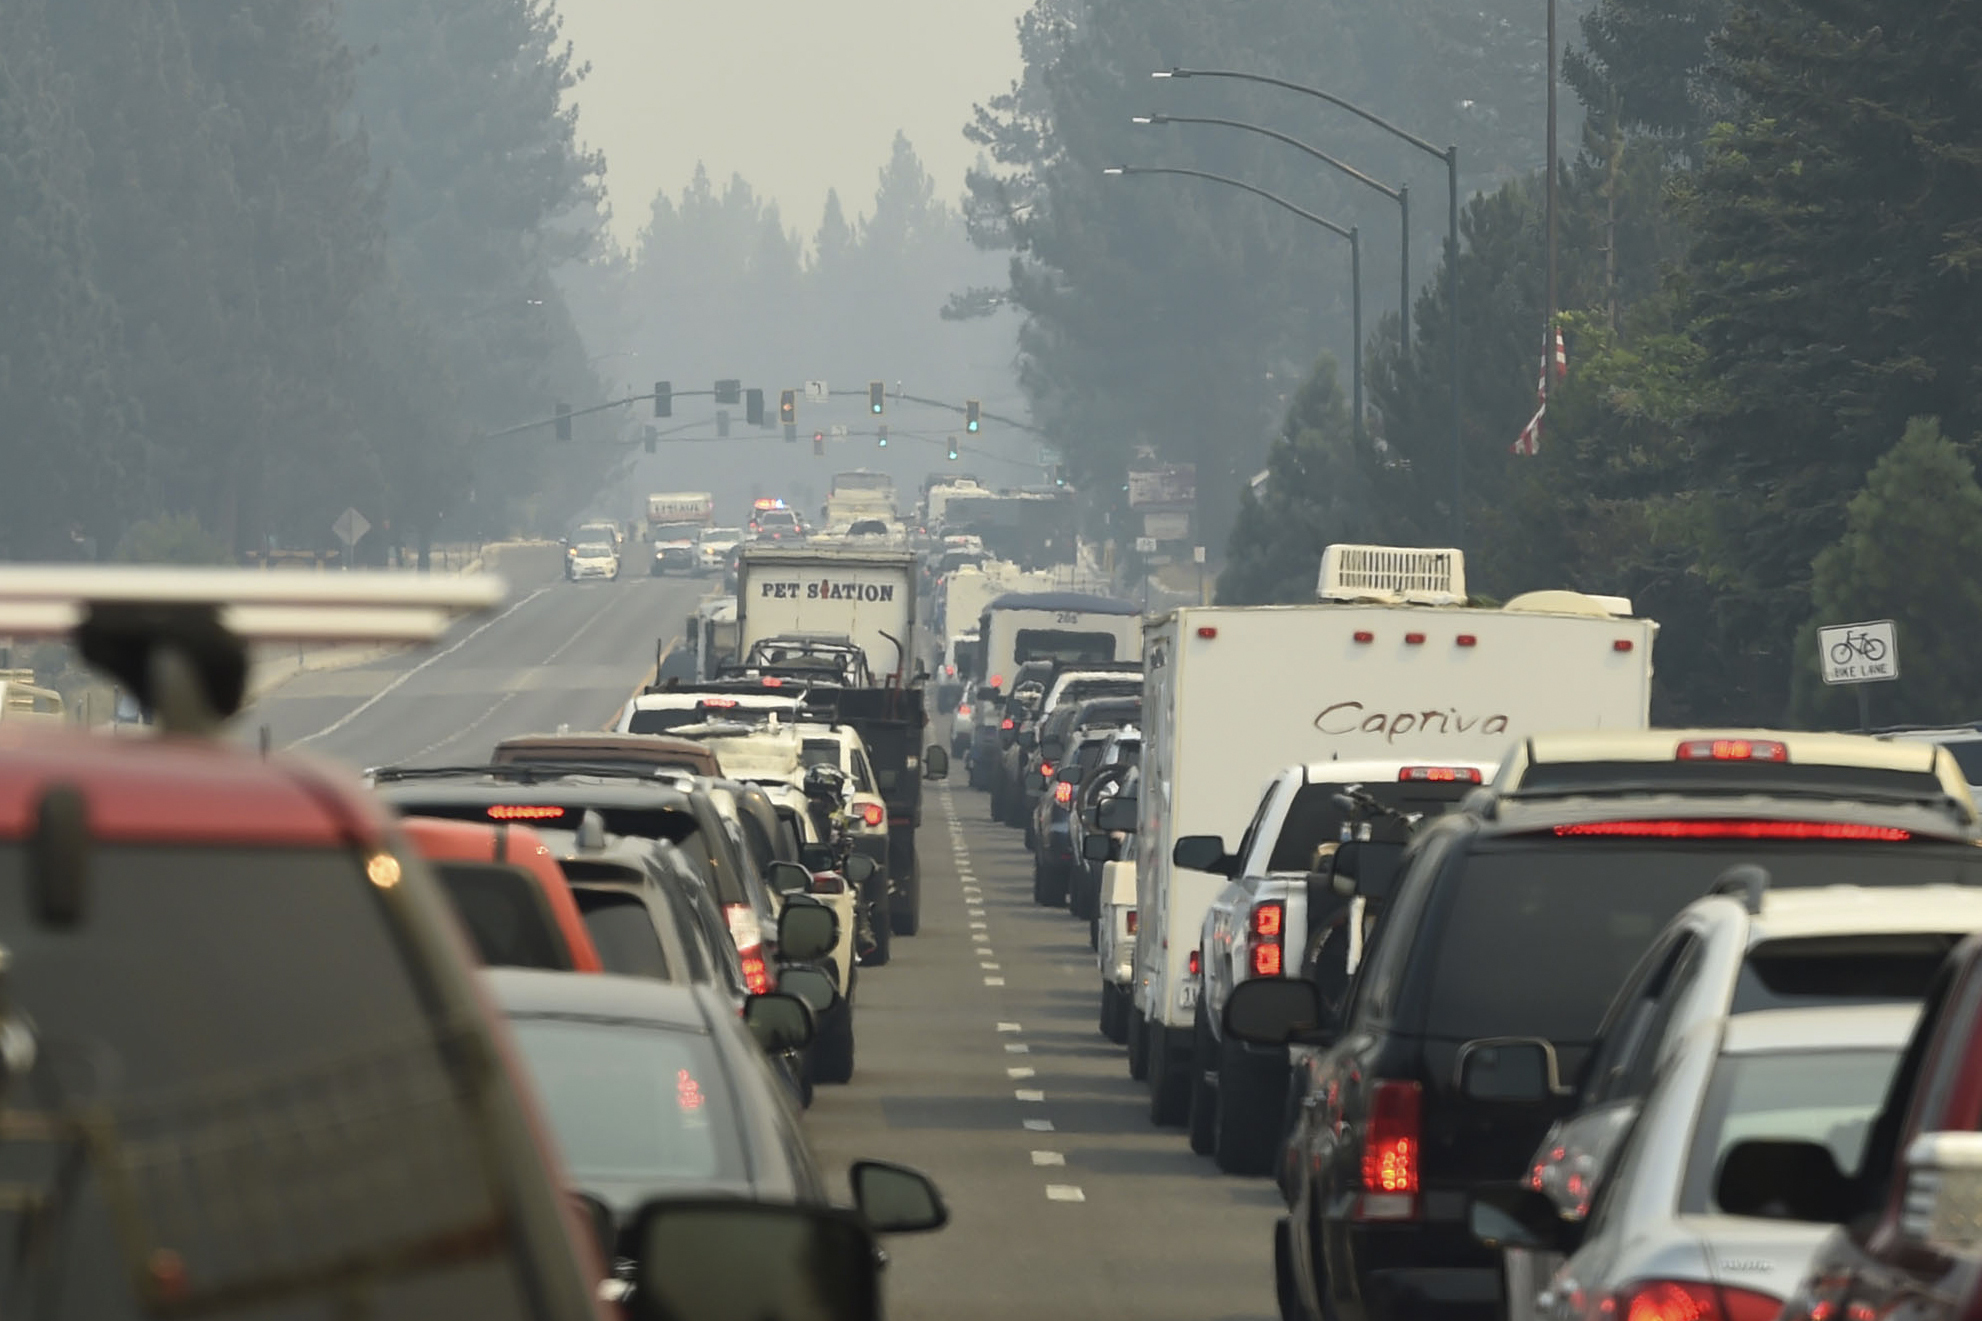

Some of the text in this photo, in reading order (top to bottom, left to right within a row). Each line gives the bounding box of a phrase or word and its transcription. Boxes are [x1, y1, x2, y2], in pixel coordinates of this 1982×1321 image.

[761, 582, 800, 599] PET
[1834, 663, 1887, 678] BIKE LANE
[1314, 701, 1509, 746] Capriva
